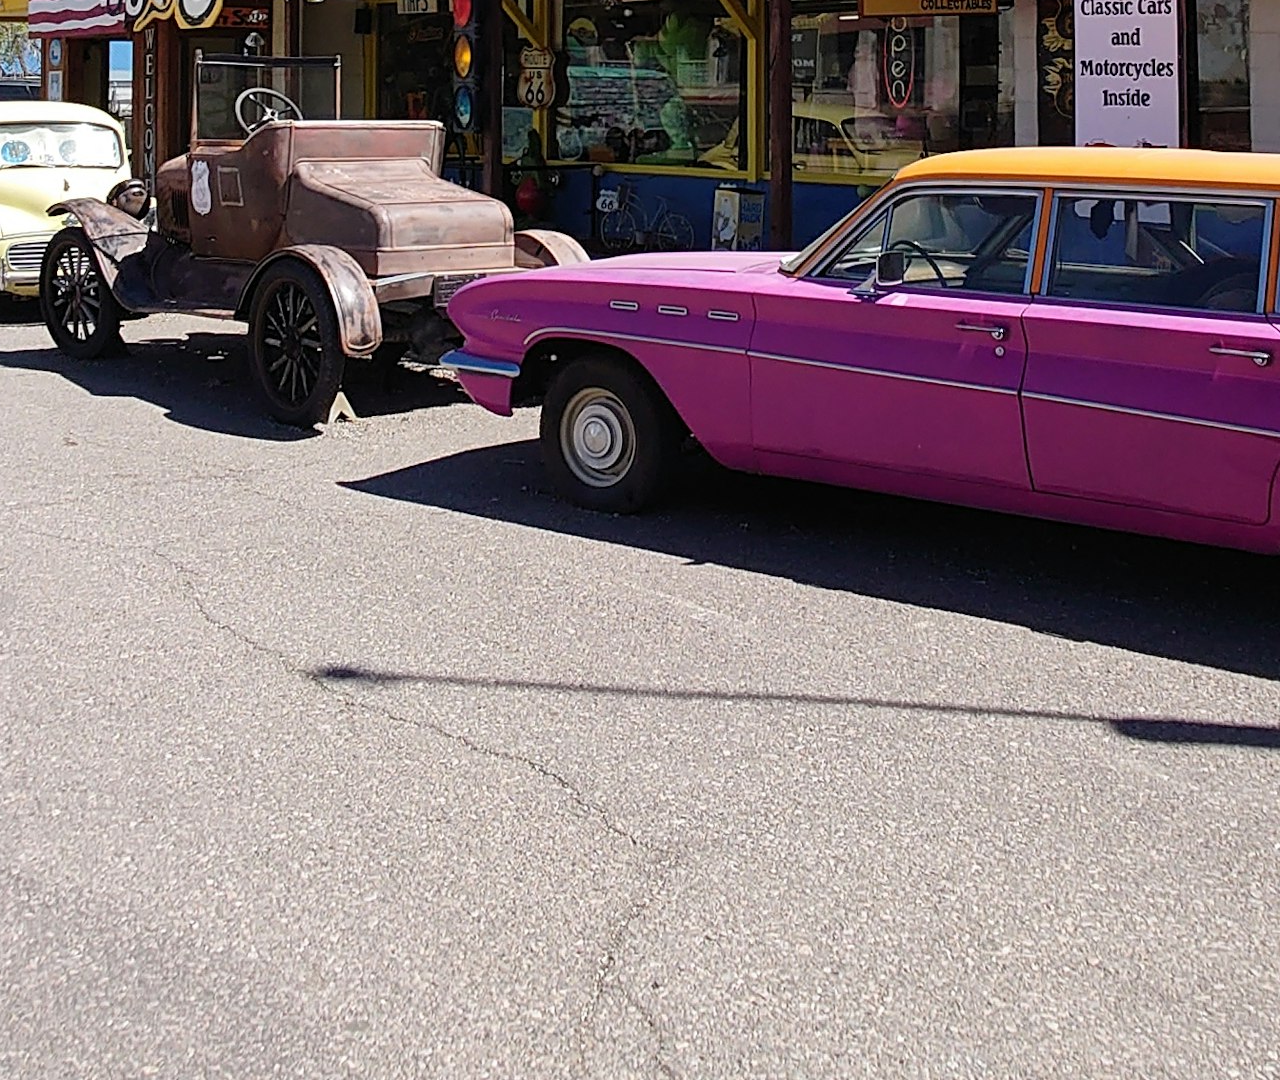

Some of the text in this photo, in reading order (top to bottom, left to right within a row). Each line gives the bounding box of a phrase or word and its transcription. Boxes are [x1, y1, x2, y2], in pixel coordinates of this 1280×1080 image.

[1111, 27, 1141, 46] and
[529, 71, 542, 79] US
[1080, 58, 1174, 81] Motorcycles
[525, 82, 545, 104] 66
[1102, 87, 1151, 107] Inside
[601, 198, 614, 210] 66
